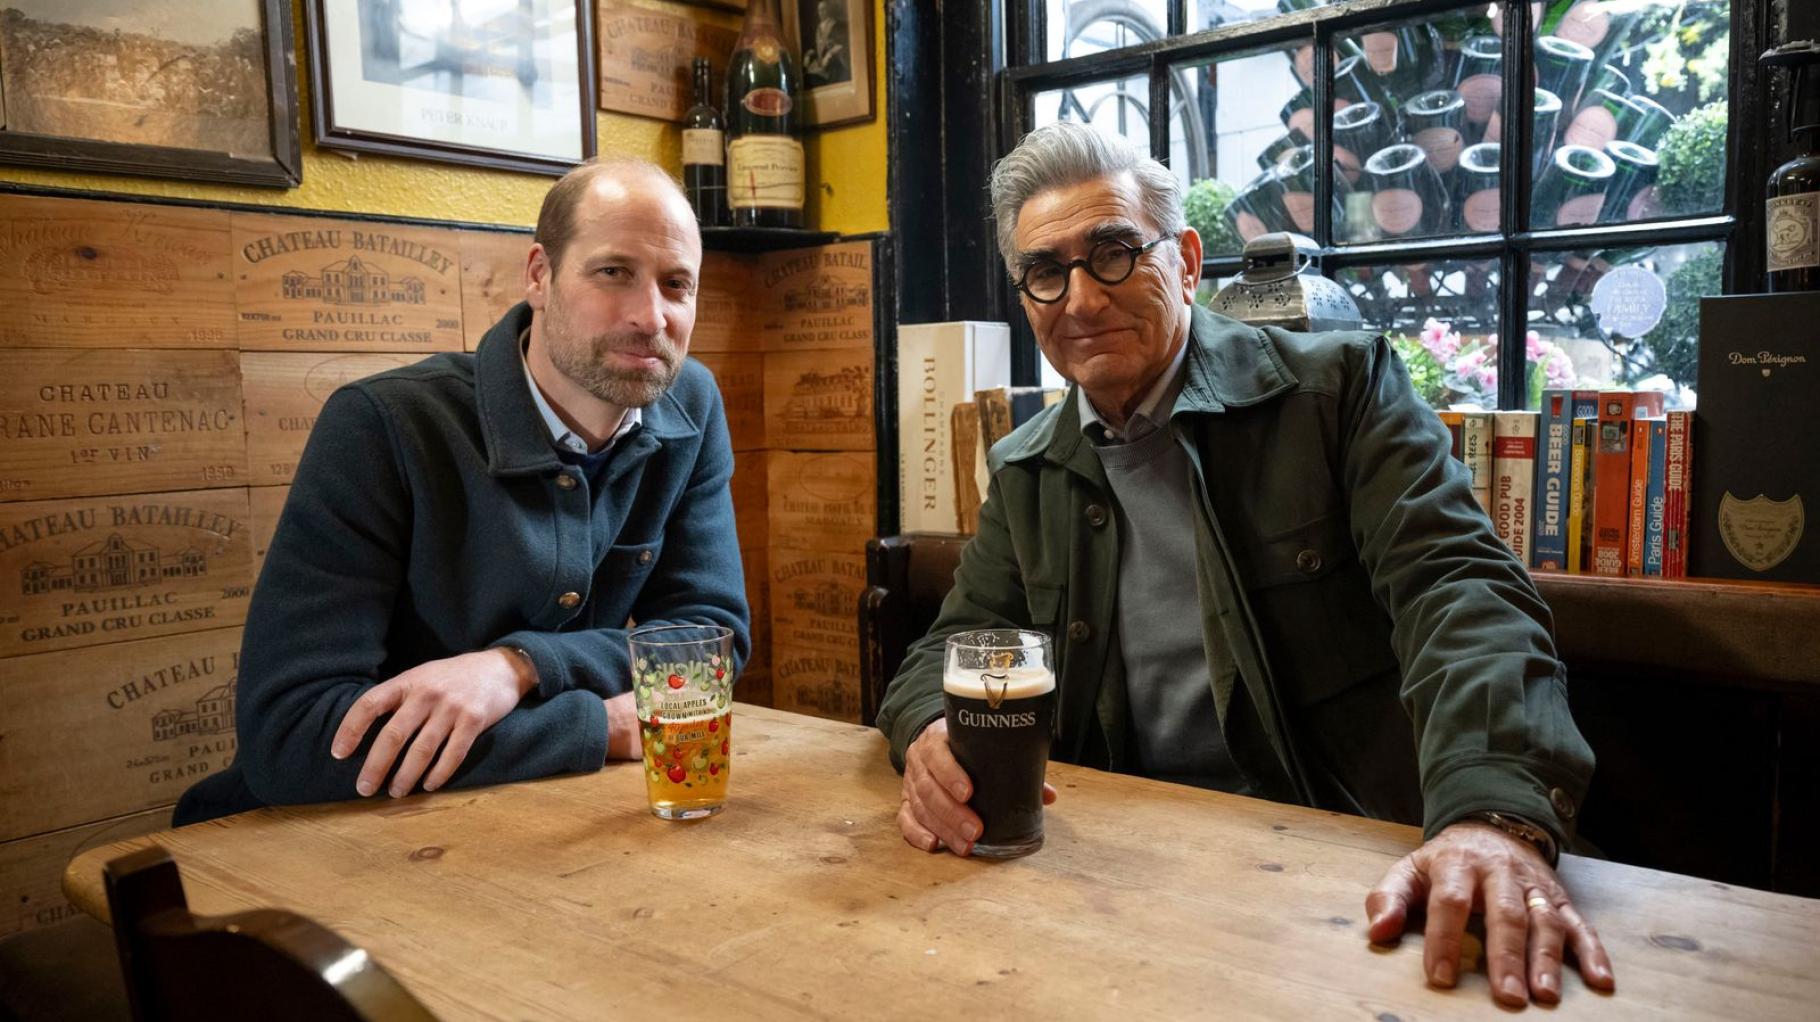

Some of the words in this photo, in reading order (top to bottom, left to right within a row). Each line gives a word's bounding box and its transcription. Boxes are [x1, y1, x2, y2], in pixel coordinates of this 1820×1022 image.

[243, 231, 341, 264] CHATEAU
[353, 231, 455, 274] BATAILLEY
[824, 252, 869, 270] BATAIL
[313, 310, 403, 325] PAUILLAC
[800, 317, 855, 329] PAUILLAC
[282, 329, 338, 342] GRAND
[344, 331, 376, 342] CRU
[380, 331, 433, 343] CLASSE
[839, 330, 869, 341] CLASS
[1728, 352, 1757, 365] Dom
[1757, 351, 1807, 368] Pérignon
[40, 383, 169, 402] CHATEAU
[0, 411, 75, 439] RANE
[88, 409, 229, 435] CANTENAC
[923, 356, 937, 511] BOLLINGER
[1670, 412, 1684, 433] THE
[108, 446, 149, 461] VIN
[1467, 434, 1478, 459] REES
[1548, 423, 1562, 474] BEER
[1669, 434, 1684, 462] PARIS
[1500, 475, 1512, 500] PUB
[1668, 463, 1683, 490] GUIDE
[1631, 479, 1644, 506] Guide
[1514, 497, 1525, 526] 2004
[1545, 477, 1561, 537] GUIDE
[1649, 496, 1664, 532] Guide
[111, 505, 244, 538] BATAILLEY
[1499, 503, 1511, 539] GOOD
[1513, 528, 1524, 561] UIDE
[1630, 509, 1643, 564] Amsterdam
[1648, 535, 1662, 566] Paris
[62, 591, 180, 617] PAUILLAC
[21, 620, 95, 642] GRAND
[102, 615, 143, 632] CRU
[148, 606, 216, 626] CLASSE
[106, 655, 216, 711] CHATEAU
[660, 700, 681, 710] LOCAL
[683, 698, 707, 709] APPLES
[958, 709, 1036, 728] GUINNESS
[149, 762, 209, 785] GRAND
